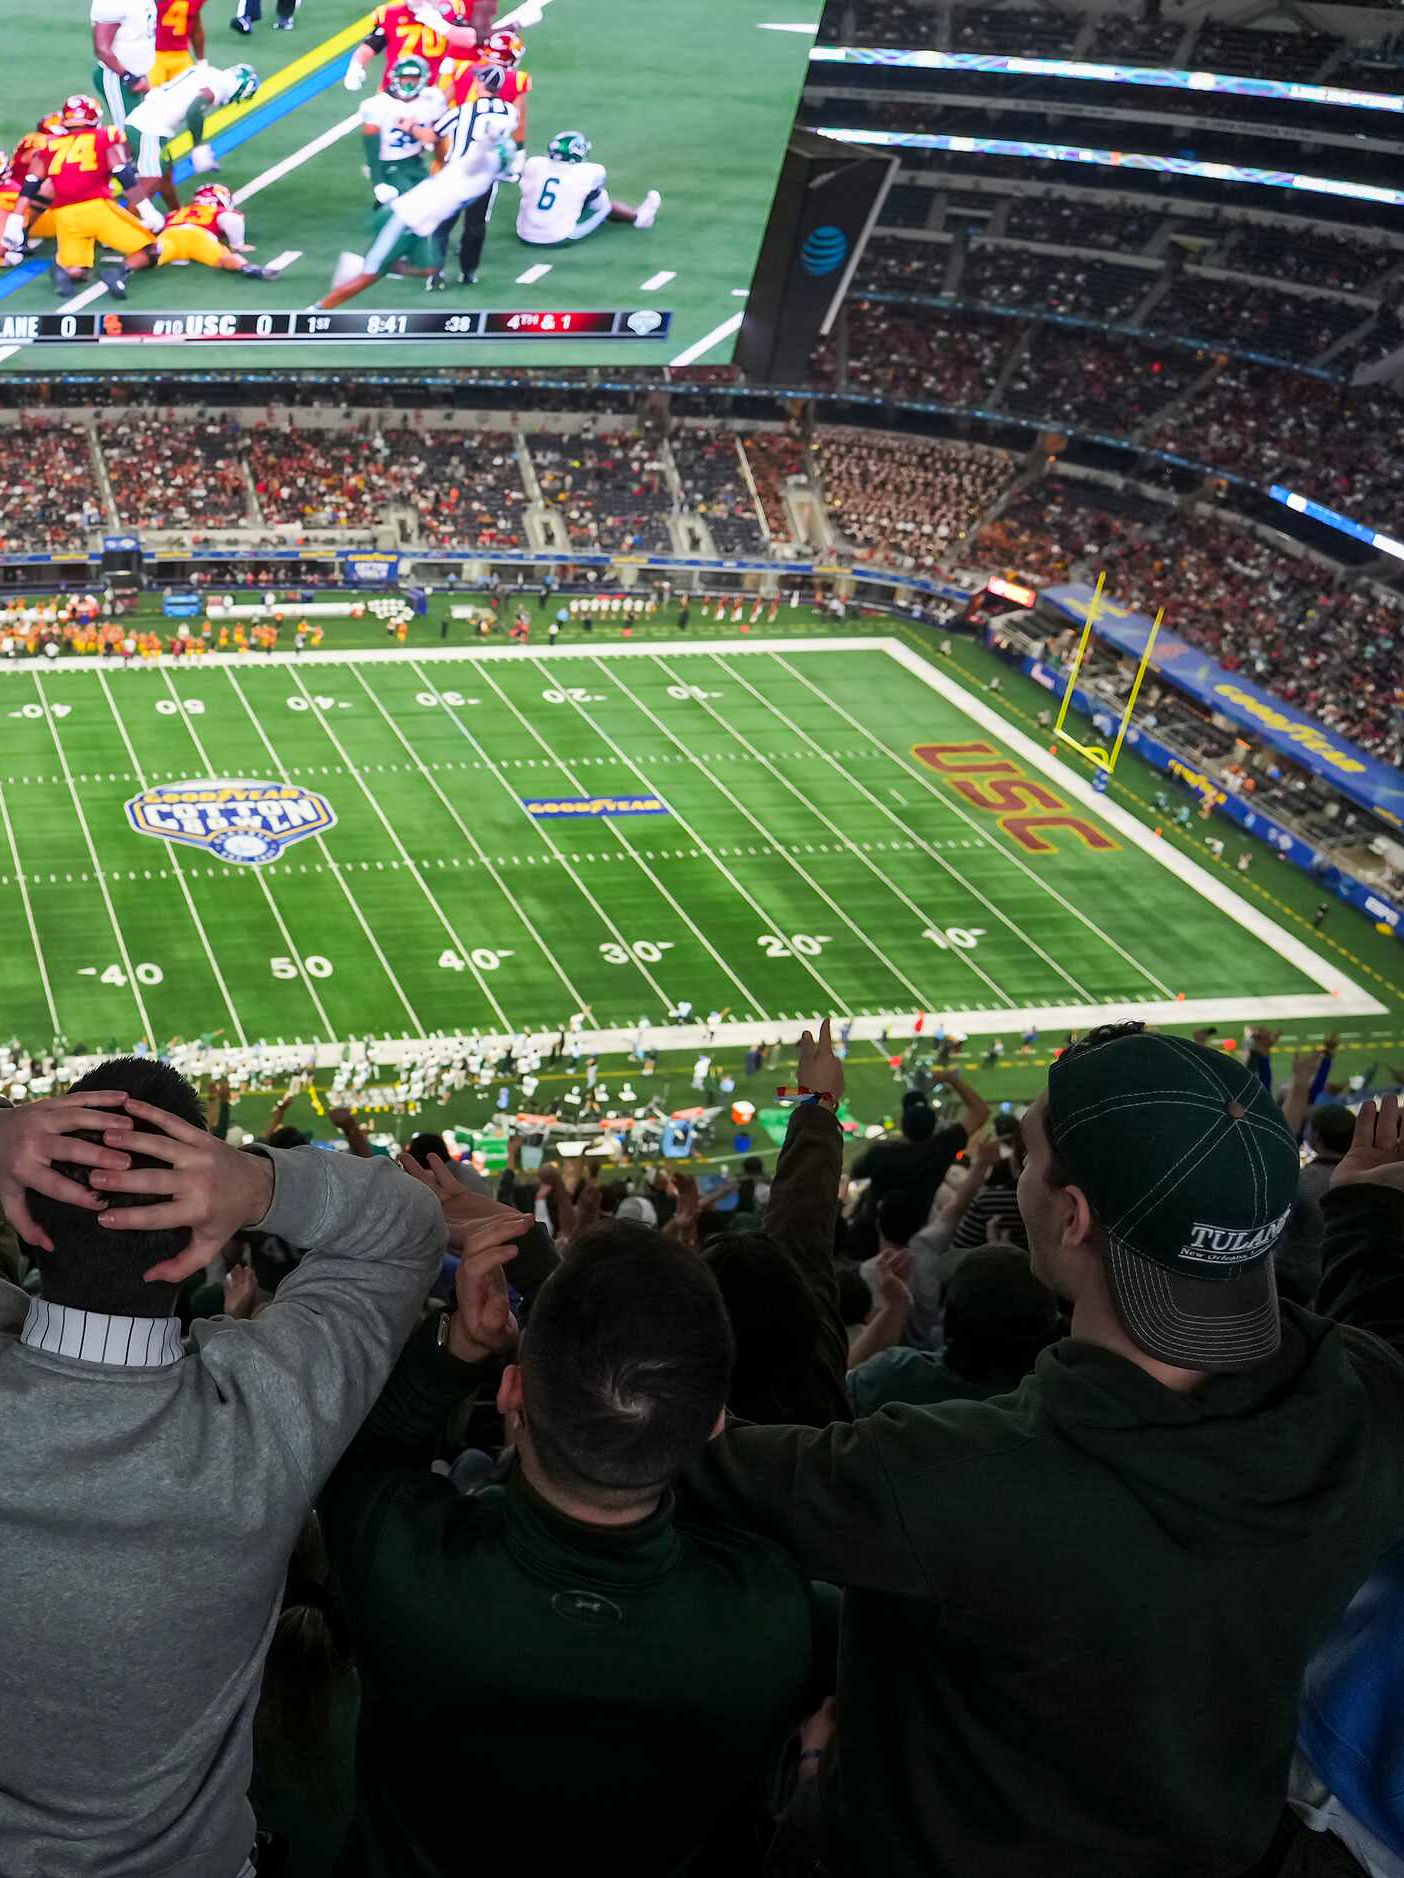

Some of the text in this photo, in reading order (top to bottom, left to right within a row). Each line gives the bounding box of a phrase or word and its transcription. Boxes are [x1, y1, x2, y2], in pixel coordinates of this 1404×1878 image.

[162, 0, 190, 36] 4
[47, 133, 99, 176] 74
[537, 177, 560, 211] 6
[60, 315, 76, 338] 0
[185, 315, 237, 337] USC
[256, 315, 273, 337] 0
[367, 315, 407, 334] 8:41
[540, 314, 555, 330] &
[561, 314, 572, 330] 1
[527, 798, 661, 814] GOODYEAR
[911, 740, 1124, 854] USC
[143, 799, 318, 832] COTTON
[757, 934, 822, 958] 20
[922, 927, 978, 950] 10
[438, 948, 501, 971] 40
[599, 940, 663, 965] 30
[100, 962, 164, 987] 40
[270, 955, 334, 980] 50
[1190, 1218, 1288, 1251] TULAN
